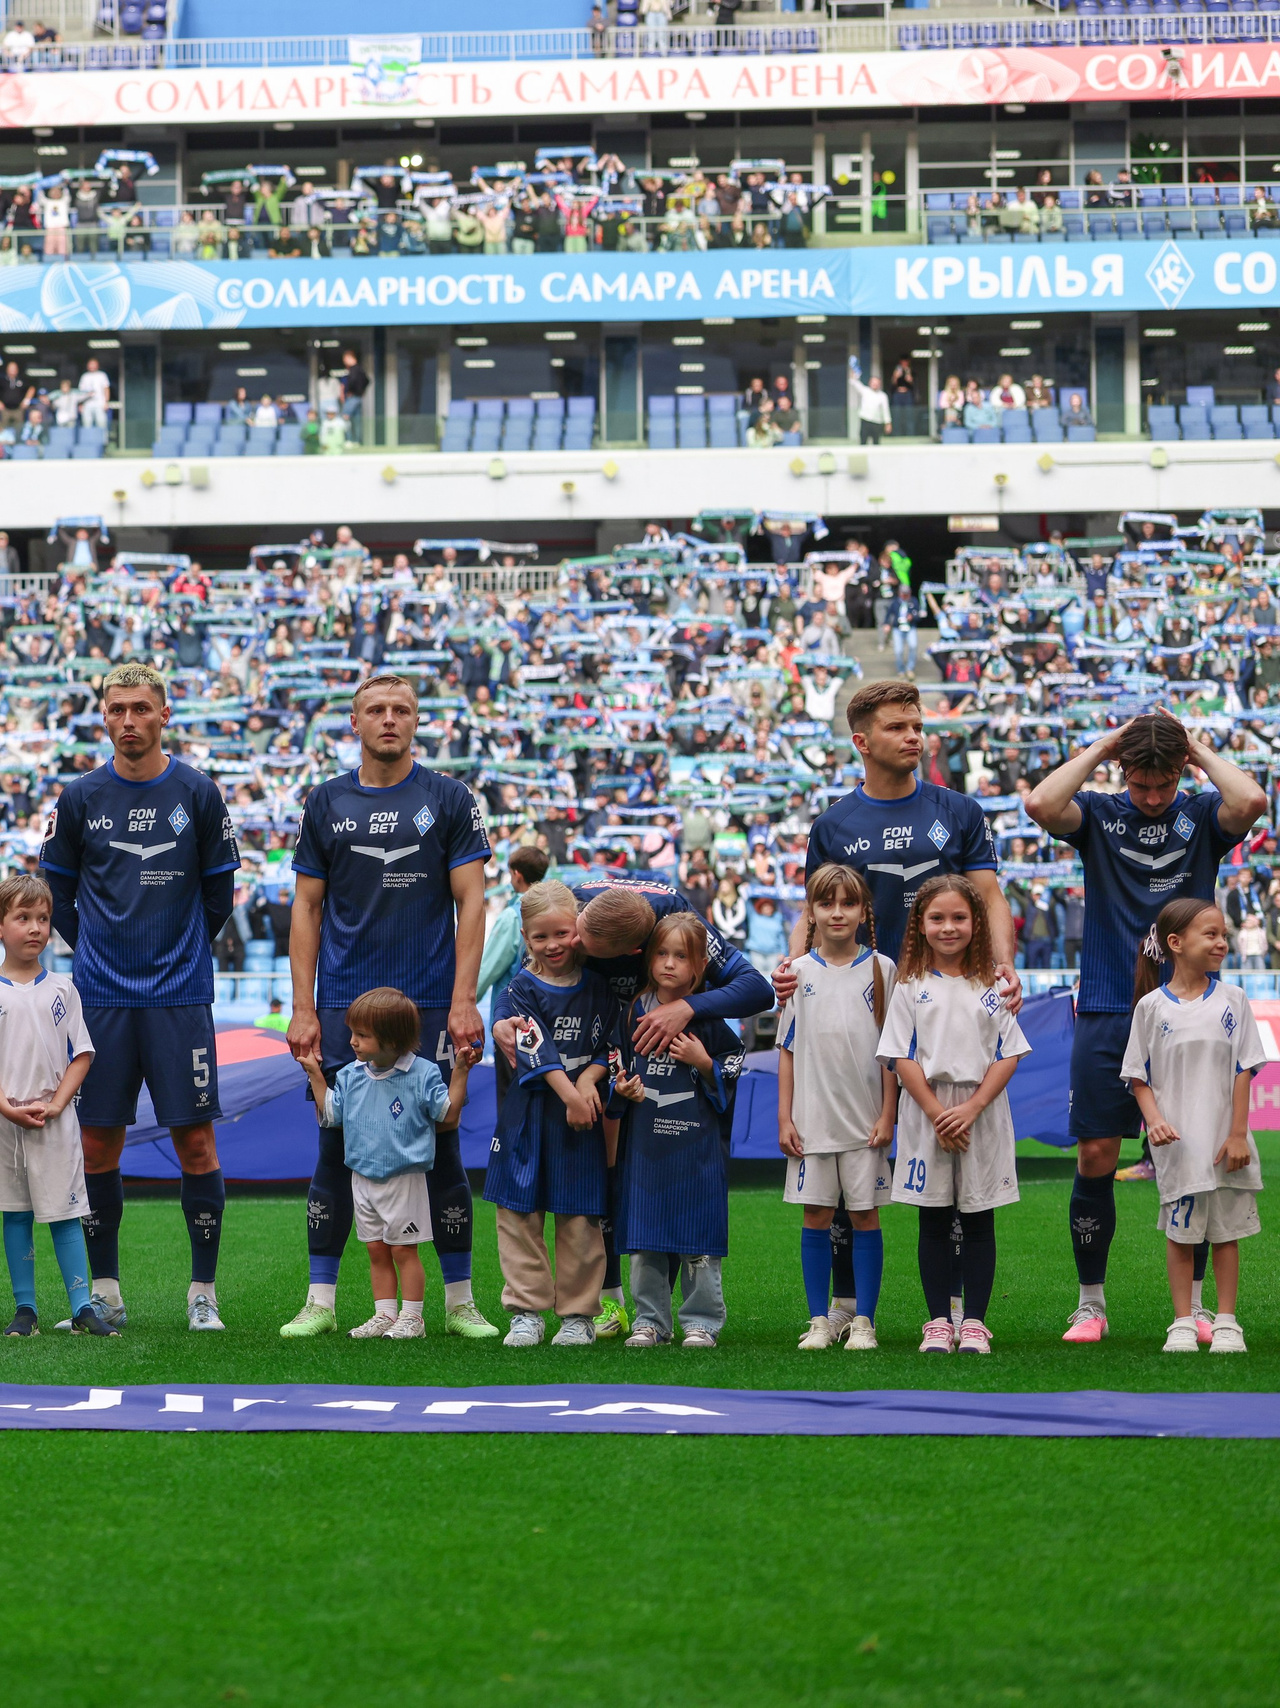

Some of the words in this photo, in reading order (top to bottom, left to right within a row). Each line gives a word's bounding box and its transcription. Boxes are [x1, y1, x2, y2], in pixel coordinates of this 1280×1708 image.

[115, 72, 491, 113] СОЛИДАРСТЬ
[514, 66, 711, 104] САМАРА
[731, 62, 878, 99] АРЕНА
[895, 255, 1124, 300] КРЫЛЬЯ
[1214, 251, 1277, 293] СО
[217, 273, 524, 310] СОЛИДАРНОСТЬ
[540, 268, 701, 303] САМАРА
[714, 267, 835, 300] АРЕНА
[128, 808, 156, 820] FON
[369, 811, 399, 822] FON
[87, 815, 114, 830] wb
[128, 820, 156, 832] BET
[332, 818, 357, 833] wb
[369, 822, 399, 834] BET
[1102, 819, 1126, 835] wb
[882, 826, 912, 839] FON
[1138, 824, 1167, 838] FON
[883, 837, 914, 850] BET
[1140, 833, 1168, 845] BET
[844, 837, 870, 856] wb
[554, 1016, 581, 1028] FON
[553, 1029, 581, 1041] BET
[192, 1047, 210, 1088] 5
[646, 1064, 677, 1077] BET
[653, 1123, 689, 1132] САМАРСКОЙ
[654, 1117, 700, 1128] ПРАВИТЕЛЬСТВО
[797, 1159, 805, 1192] 8
[903, 1158, 926, 1193] 19
[1169, 1195, 1194, 1228] 27
[204, 1229, 210, 1239] 5
[1080, 1233, 1092, 1245] 10
